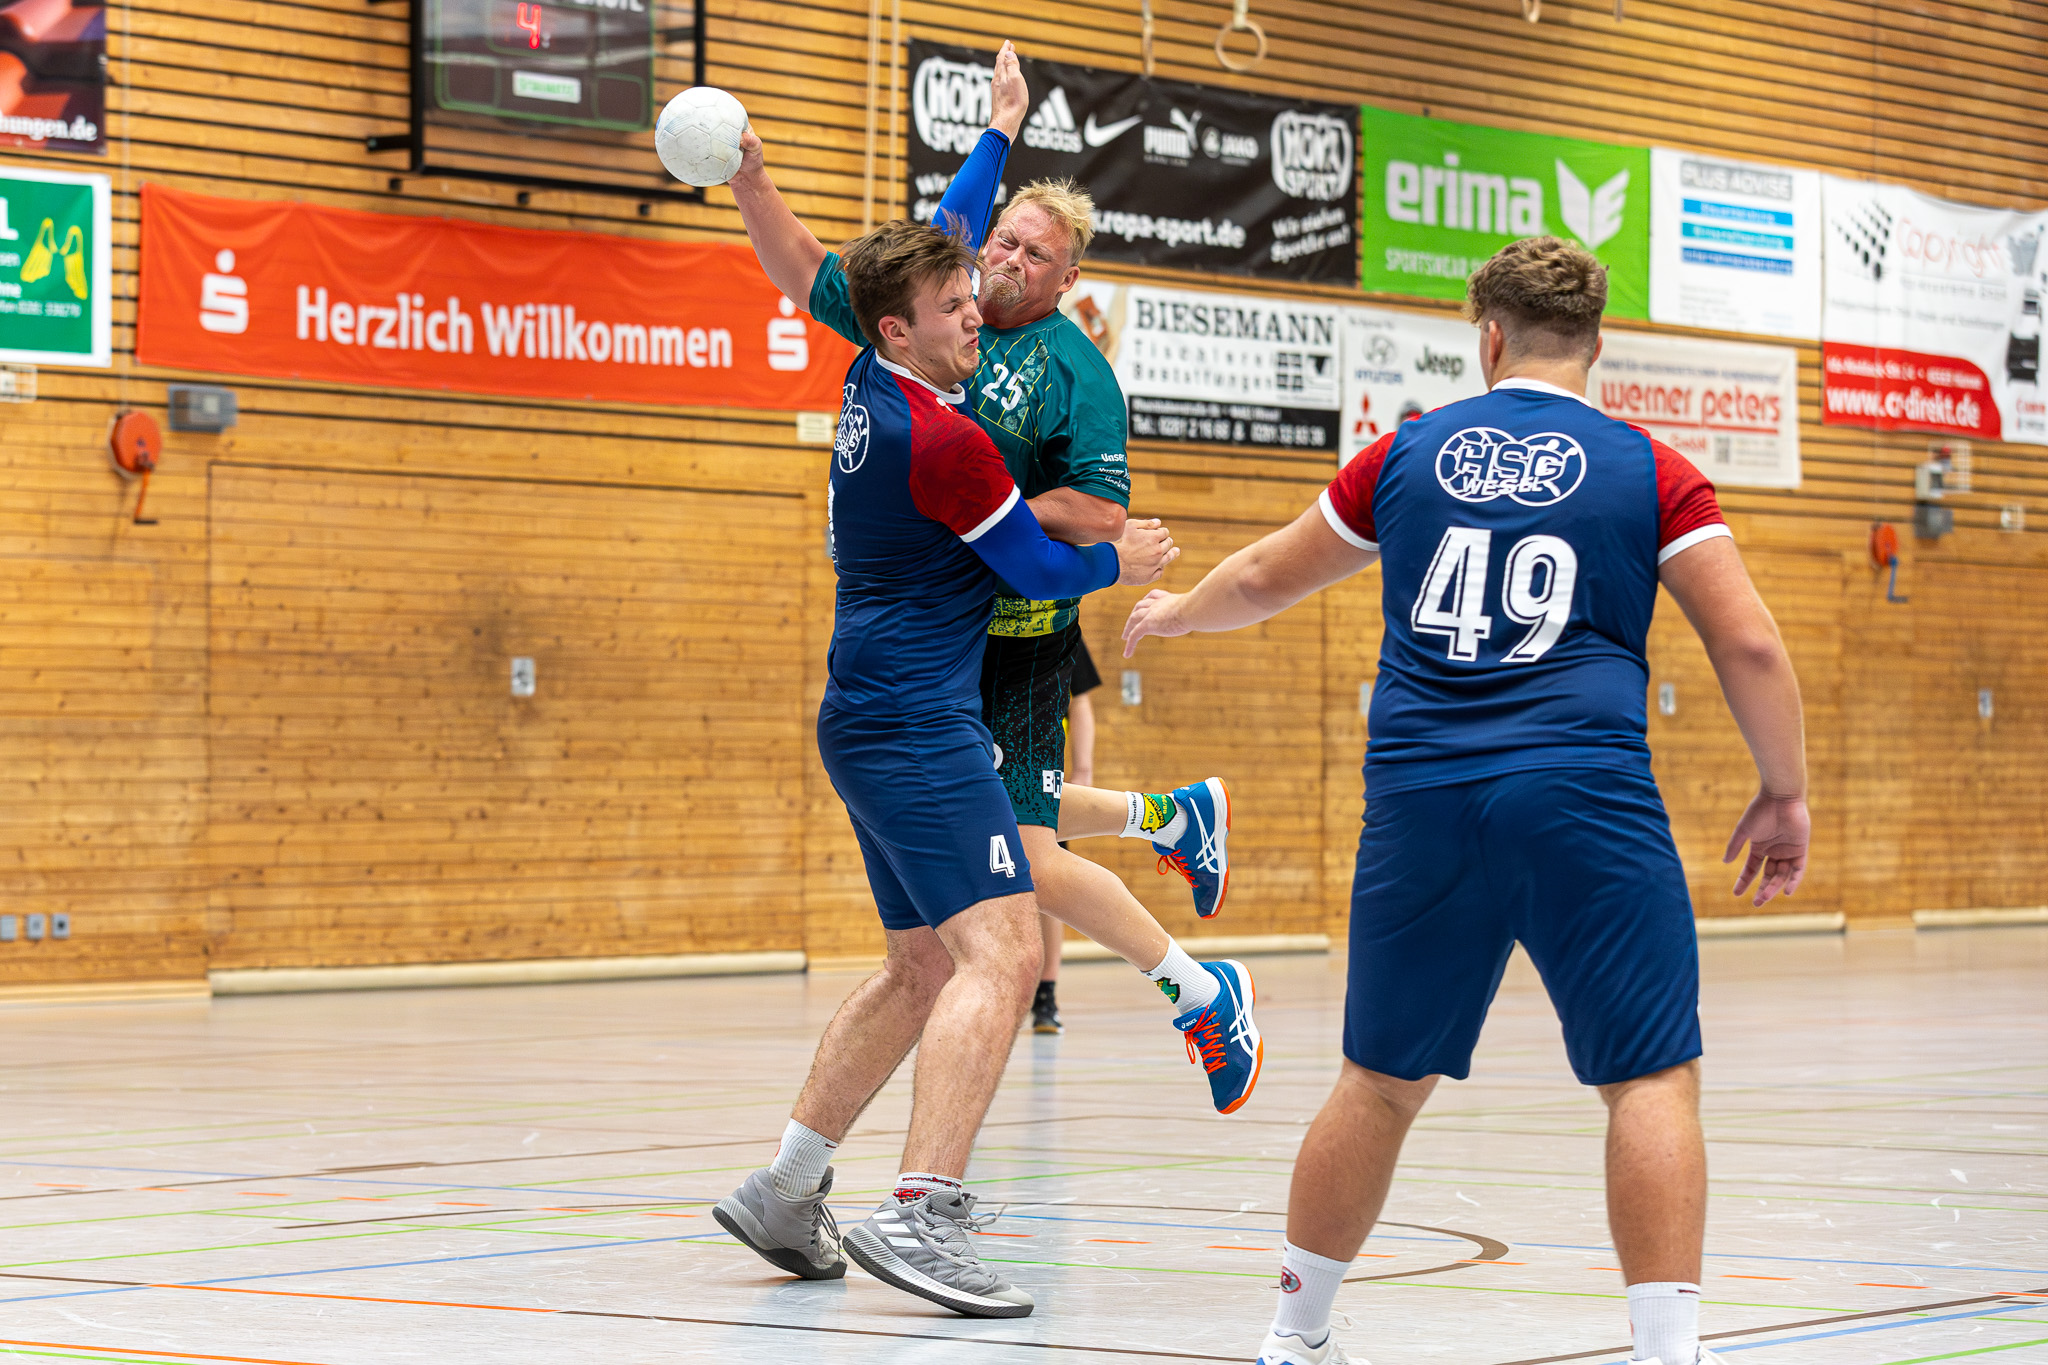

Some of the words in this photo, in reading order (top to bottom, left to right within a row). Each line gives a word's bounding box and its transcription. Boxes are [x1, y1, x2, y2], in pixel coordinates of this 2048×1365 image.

[1024, 126, 1083, 153] adidas
[1144, 125, 1191, 158] PUMA
[1221, 133, 1258, 159] JAKO
[1386, 151, 1543, 236] erima
[1683, 163, 1728, 192] PLUS
[1731, 172, 1791, 199] ADVISE
[296, 284, 474, 355] Herzlich
[480, 301, 733, 368] Willkommen
[1135, 298, 1334, 346] BIESEMANN
[1135, 338, 1275, 366] Tischlerei
[1415, 343, 1465, 382] Jeep
[981, 363, 1025, 411] 25
[1134, 362, 1273, 394] Bestattungen
[1601, 380, 1693, 416] werner
[1701, 384, 1781, 428] peters
[1455, 441, 1566, 484] HSG
[1463, 476, 1544, 495] WESEL
[1411, 526, 1578, 663] 49
[989, 834, 1016, 878] 4
